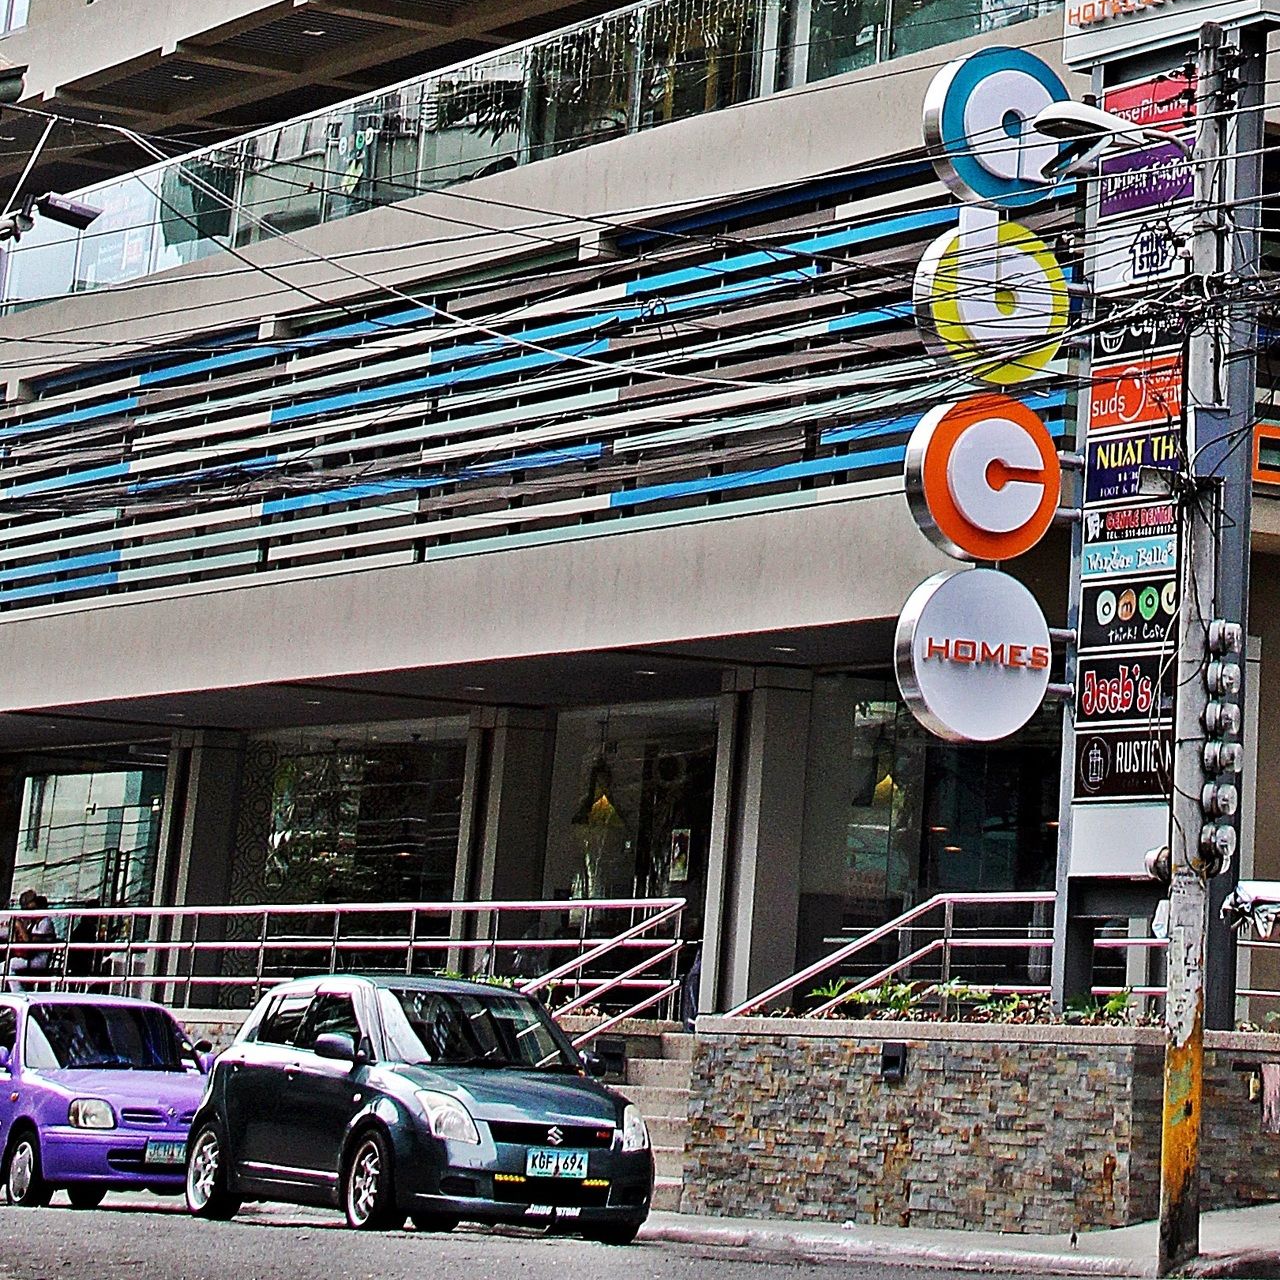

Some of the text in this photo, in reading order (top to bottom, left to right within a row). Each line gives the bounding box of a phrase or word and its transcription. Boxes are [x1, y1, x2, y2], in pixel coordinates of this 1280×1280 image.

[1092, 395, 1126, 418] suds
[1096, 439, 1146, 470] NUAT
[923, 637, 1049, 670] HOMES
[1081, 663, 1152, 716] Jeeb's
[1116, 741, 1160, 774] RUSTIC
[531, 1152, 584, 1171] KGF 694
